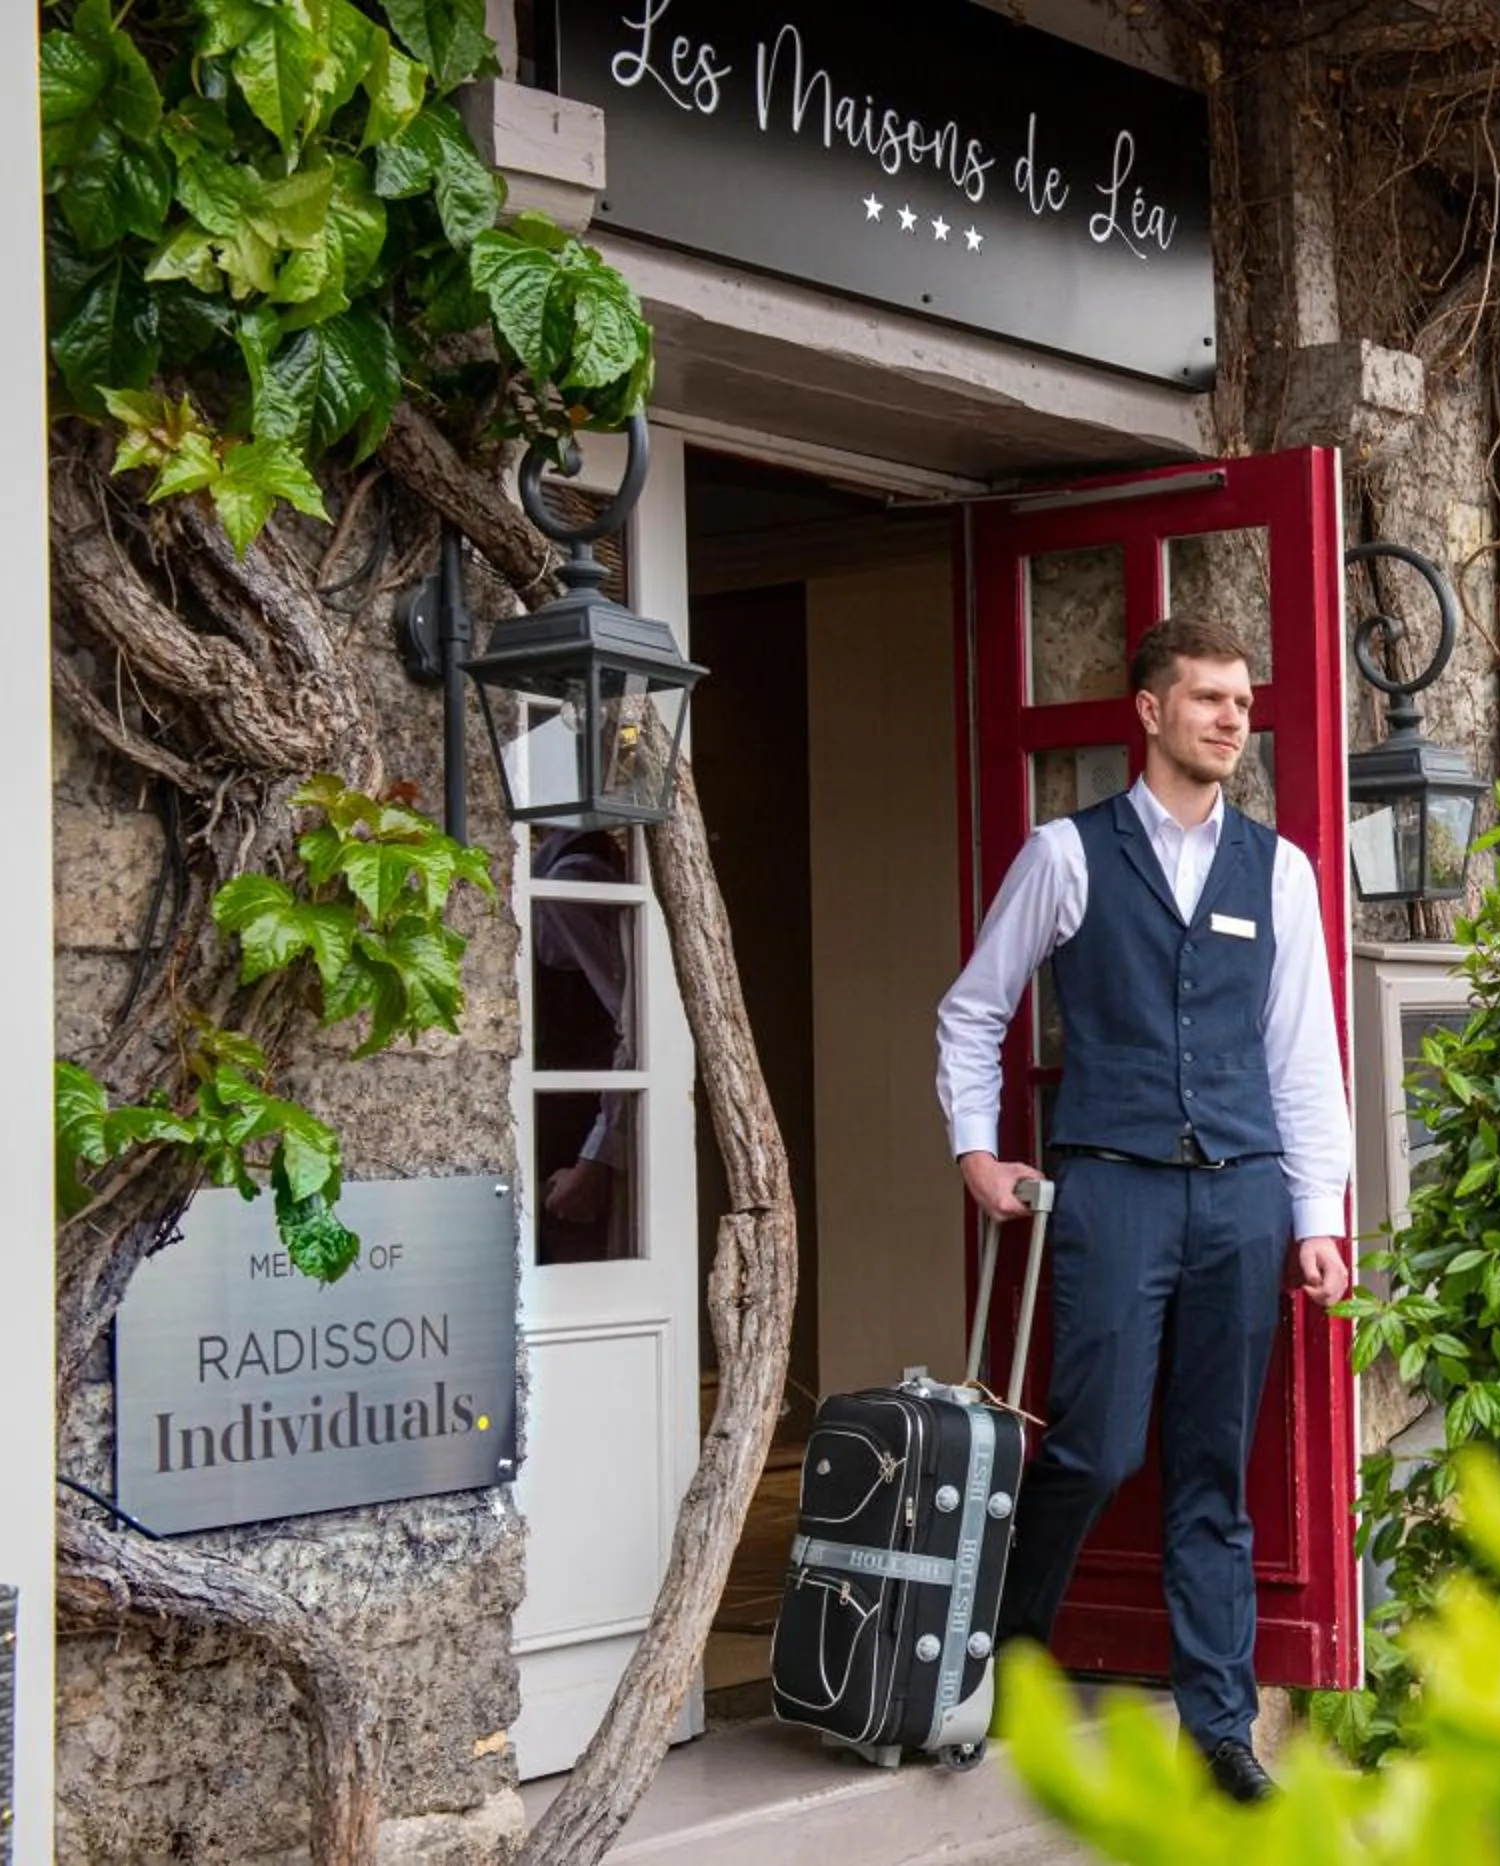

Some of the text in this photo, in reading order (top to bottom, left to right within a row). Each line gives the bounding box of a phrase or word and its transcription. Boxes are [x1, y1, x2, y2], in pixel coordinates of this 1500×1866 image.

[611, 0, 1177, 259] Les Maisons de Léa
[370, 1244, 404, 1270] OF
[198, 1313, 450, 1383] RADISSON
[155, 1381, 490, 1473] Individuals.
